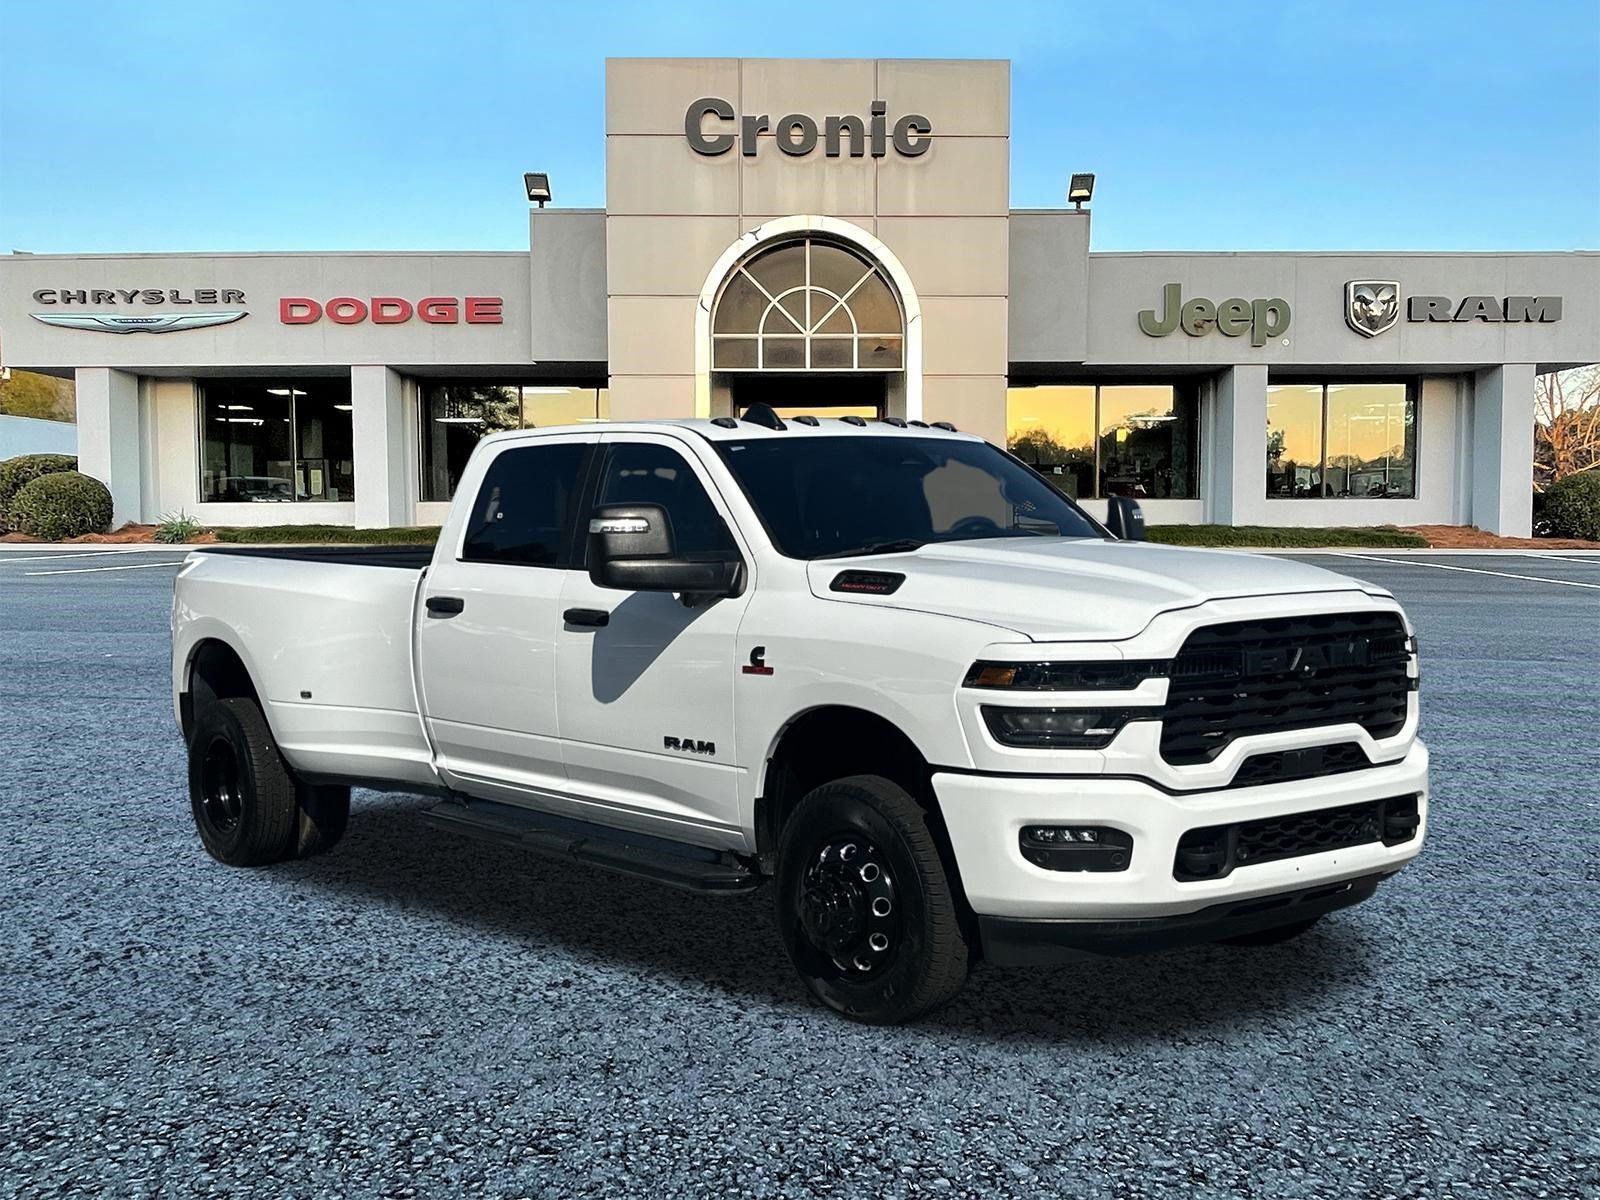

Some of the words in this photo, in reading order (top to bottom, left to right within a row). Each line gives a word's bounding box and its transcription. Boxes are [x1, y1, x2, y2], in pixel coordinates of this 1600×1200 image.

[685, 97, 932, 158] Cronic
[32, 289, 246, 304] CHRYSLER
[1407, 296, 1563, 323] RAM
[280, 297, 503, 324] DODGE
[1138, 283, 1291, 347] Jeep
[664, 736, 716, 756] RAM
